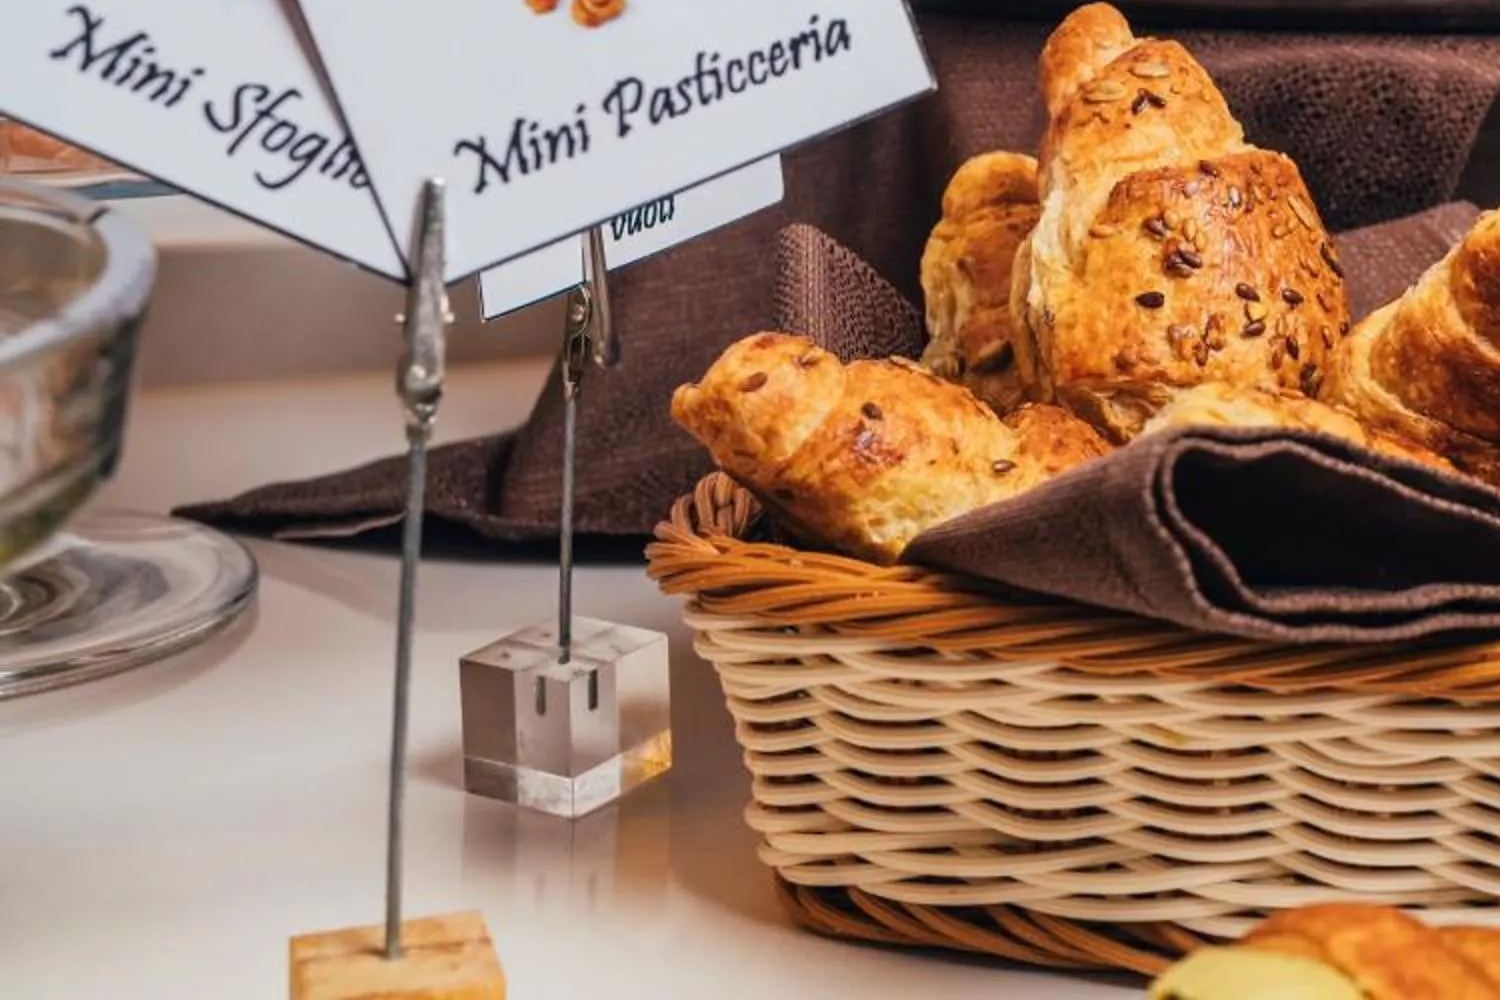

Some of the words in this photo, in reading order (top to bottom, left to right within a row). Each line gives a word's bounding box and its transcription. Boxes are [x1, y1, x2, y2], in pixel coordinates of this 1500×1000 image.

[49, 4, 206, 108] Mini
[453, 104, 590, 195] Mini
[602, 13, 852, 139] Pasticceria
